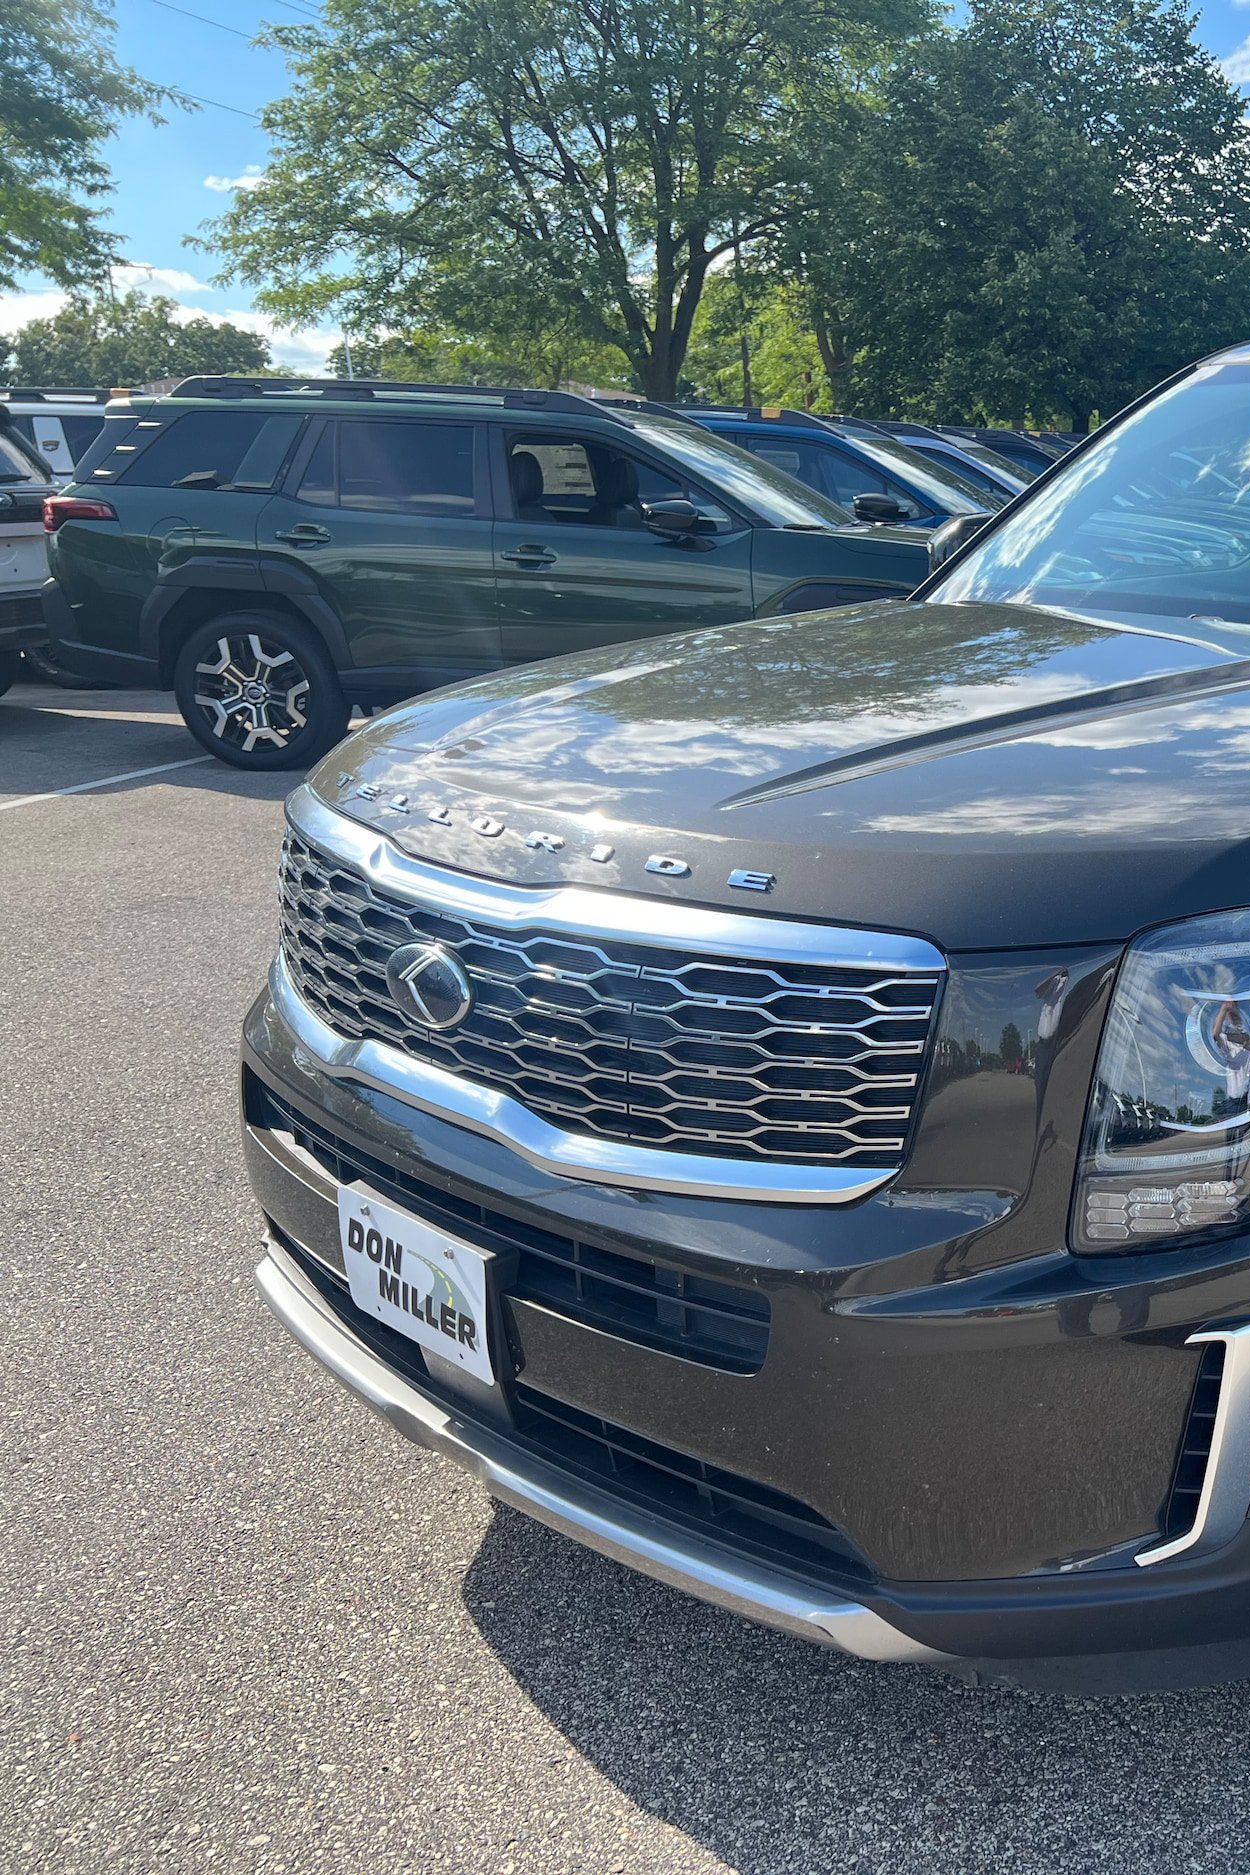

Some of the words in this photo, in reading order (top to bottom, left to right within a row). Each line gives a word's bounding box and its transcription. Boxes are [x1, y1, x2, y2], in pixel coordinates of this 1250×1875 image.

[336, 771, 778, 894] TELLURIDE
[348, 1217, 403, 1276] DON
[379, 1267, 479, 1354] MILLER
